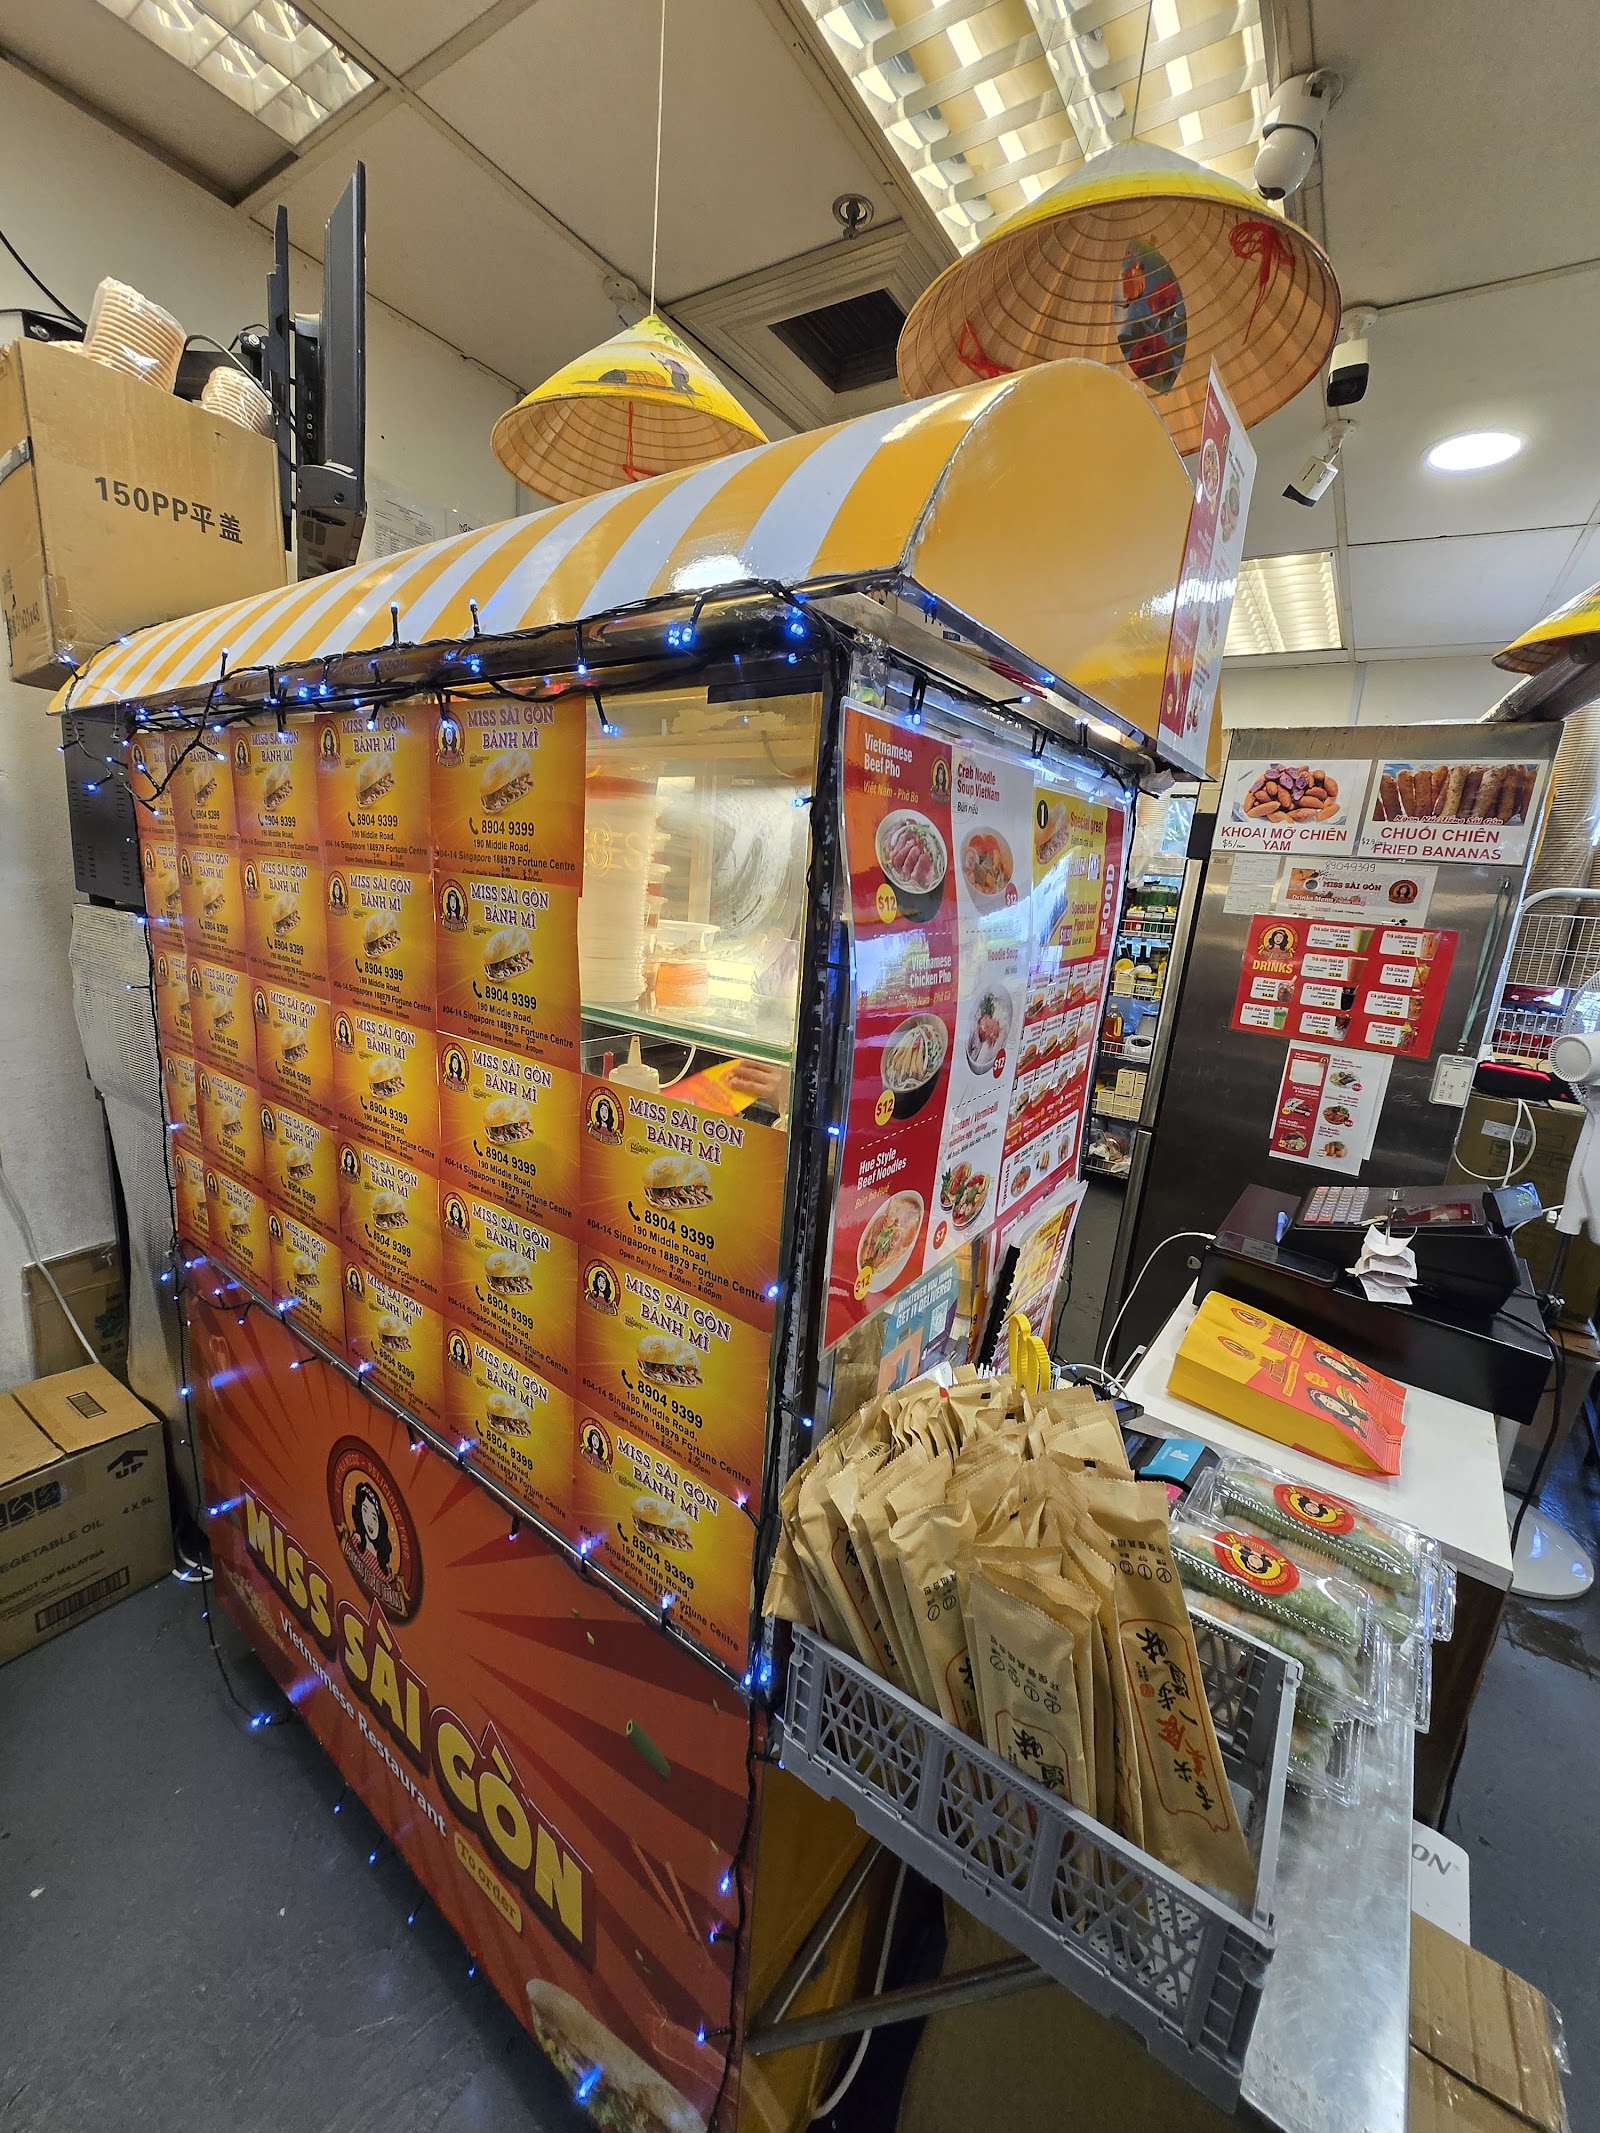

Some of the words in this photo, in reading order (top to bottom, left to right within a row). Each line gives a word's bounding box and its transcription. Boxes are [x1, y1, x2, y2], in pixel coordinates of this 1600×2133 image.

[95, 476, 243, 545] 150PP平盖
[864, 732, 913, 763] Vietnamese
[864, 753, 884, 774] Beef
[885, 757, 900, 778] Pho
[958, 764, 974, 780] Crab
[975, 768, 996, 785] Noodle
[863, 780, 876, 796] Việt
[877, 784, 893, 798] Nam
[957, 779, 975, 798] Soup
[975, 784, 1000, 802] VietNam
[1040, 804, 1045, 826] 1
[1070, 811, 1090, 832] Special
[1090, 815, 1104, 835] great
[1393, 815, 1419, 823] Ngon
[1220, 826, 1266, 838] KHOAI
[1299, 828, 1348, 841] CHIÊN
[1263, 840, 1291, 851] YAM
[1442, 827, 1499, 843] CHIÊN
[1372, 843, 1418, 856] FRIED
[1422, 846, 1503, 860] BANANAS
[1322, 880, 1342, 889] MISS
[878, 894, 897, 912] $12
[1071, 902, 1087, 916] Special
[1099, 863, 1115, 936] FOOD
[1292, 893, 1313, 902] Drinks
[911, 955, 952, 971] Vietnamese
[1252, 959, 1293, 974] DRINKS
[910, 972, 938, 989] Chicken
[939, 969, 952, 983] Pho
[356, 1017, 376, 1035] MISS
[378, 1023, 393, 1040] SÀI
[472, 1049, 499, 1070] MISS
[502, 1057, 520, 1078] SÀI
[523, 1065, 552, 1087] GÒN
[994, 1056, 1005, 1071] $12
[485, 1073, 518, 1098] BÁNH
[521, 1085, 537, 1103] MÌ
[369, 1100, 388, 1117] 8904
[389, 1108, 408, 1125] 9399
[875, 1099, 893, 1117] $12
[629, 1096, 666, 1125] MISS
[670, 1105, 699, 1133] SÀI
[702, 1117, 744, 1148] GÒN
[646, 1124, 693, 1156] BÁNH
[698, 1139, 722, 1165] MÌ
[486, 1146, 508, 1165] 8904
[511, 1156, 536, 1176] 9399
[859, 1160, 875, 1175] Hue
[875, 1148, 897, 1168] Style
[857, 1173, 876, 1191] Beef
[876, 1157, 907, 1181] Noodles
[644, 1209, 676, 1235] 8904
[680, 1224, 715, 1250] 9399
[935, 1227, 945, 1242] $7
[632, 1224, 648, 1238] 190
[649, 1231, 680, 1251] Middle
[682, 1242, 710, 1266] Road,
[587, 1218, 612, 1236] #04-14
[614, 1229, 657, 1256] Singapore
[659, 1248, 690, 1271] 188979
[692, 1264, 729, 1288] Fortune
[732, 1281, 766, 1303] Centre
[619, 1248, 635, 1261] Open
[635, 1254, 651, 1269] Daily
[652, 1261, 668, 1277] from
[855, 1274, 871, 1294] $12
[624, 1272, 661, 1305] MISS
[663, 1291, 690, 1321] SÀI
[693, 1308, 732, 1342] GÒN
[896, 1307, 914, 1329] GET
[913, 1301, 920, 1316] IT
[919, 1278, 952, 1313] DELIVERED
[898, 1285, 927, 1313] WHATEVER
[639, 1302, 685, 1340] BÁNH
[688, 1324, 711, 1354] MÌ
[637, 1379, 667, 1409] 8904
[671, 1399, 703, 1430] 9399
[115, 1461, 144, 1480] UP
[81, 1518, 105, 1535] OIL
[57, 1549, 105, 1578] MALAYSIA
[245, 1490, 332, 1638] MISS
[343, 1618, 422, 1756] SÀI
[436, 1721, 584, 1944] GÒN
[278, 1609, 356, 1721] Vietnamese
[357, 1714, 448, 1837] Restaurant
[457, 1834, 479, 1873] To
[477, 1862, 518, 1920] order
